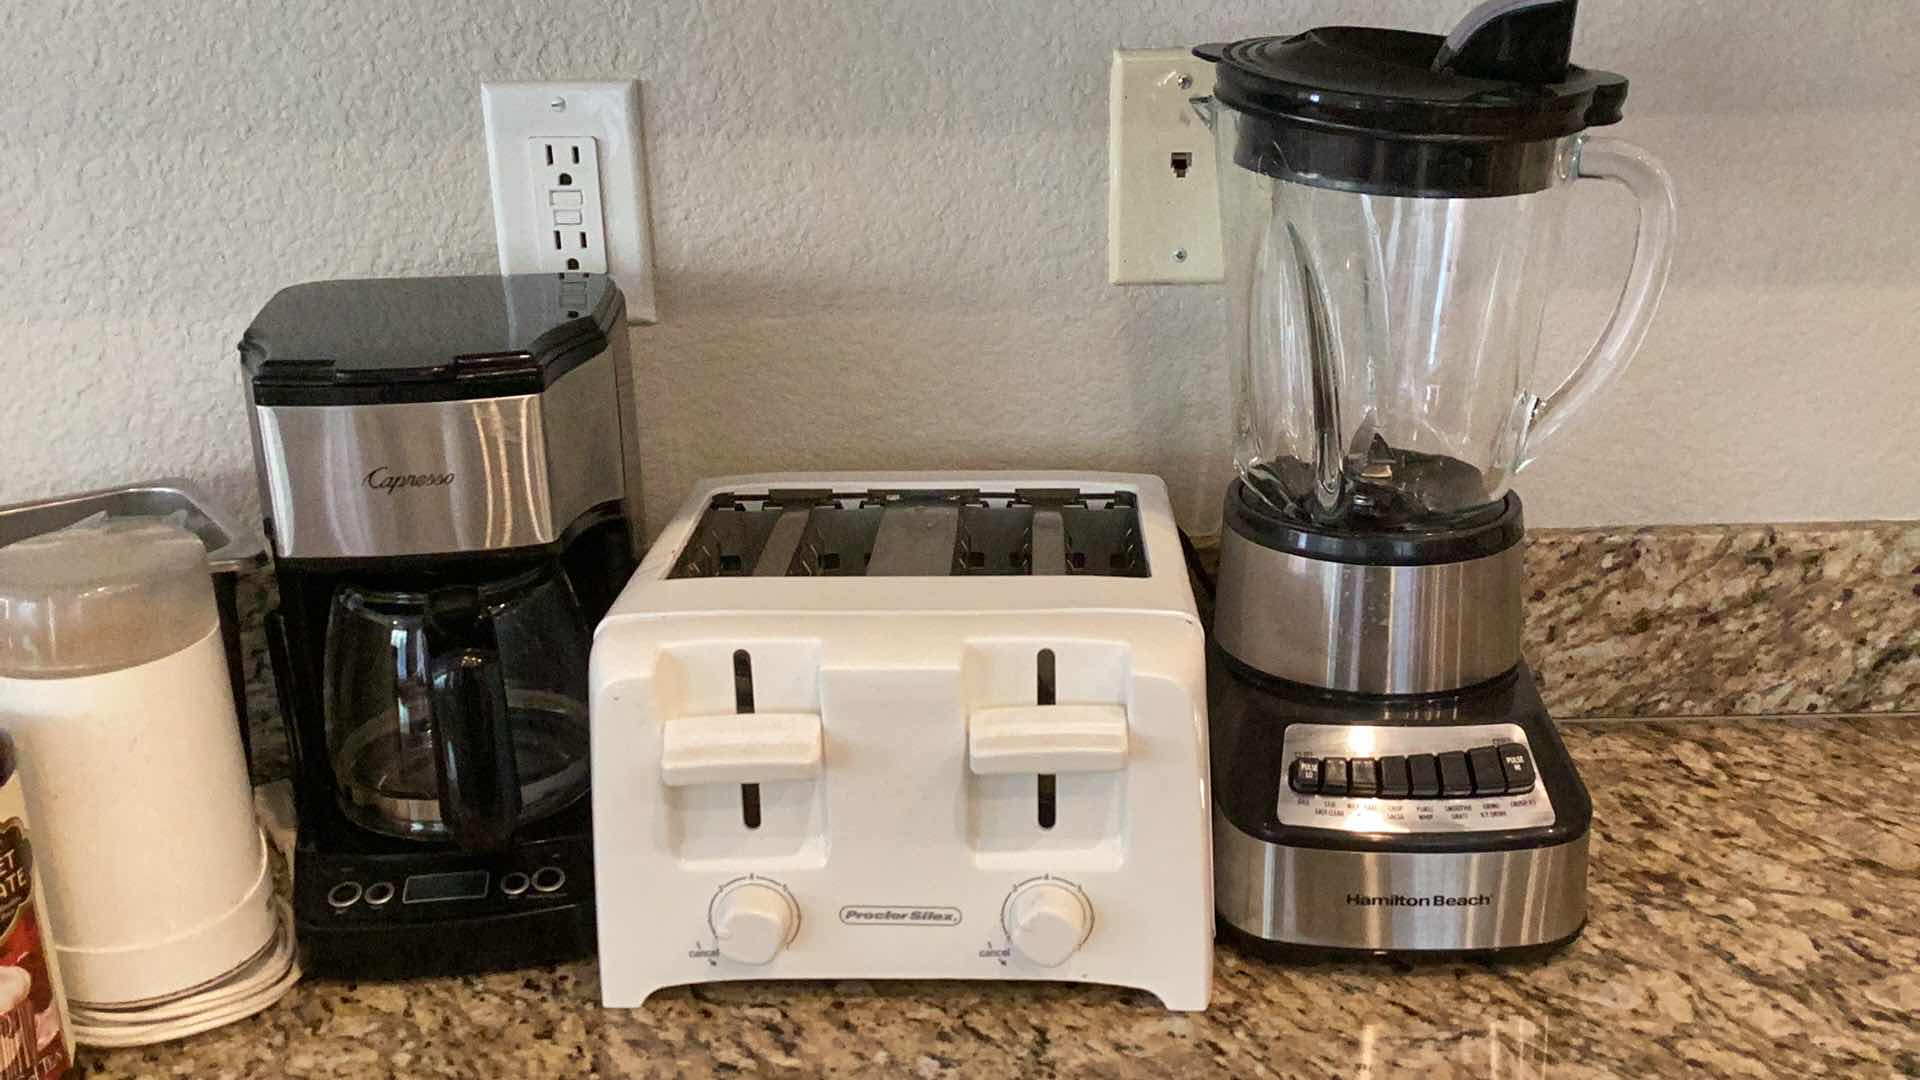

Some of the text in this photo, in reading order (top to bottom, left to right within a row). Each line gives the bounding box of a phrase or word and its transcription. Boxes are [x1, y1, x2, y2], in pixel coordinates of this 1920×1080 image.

[361, 465, 456, 495] Capresso
[1346, 893, 1491, 907] Hamilton Beach
[845, 910, 909, 921] Proctor
